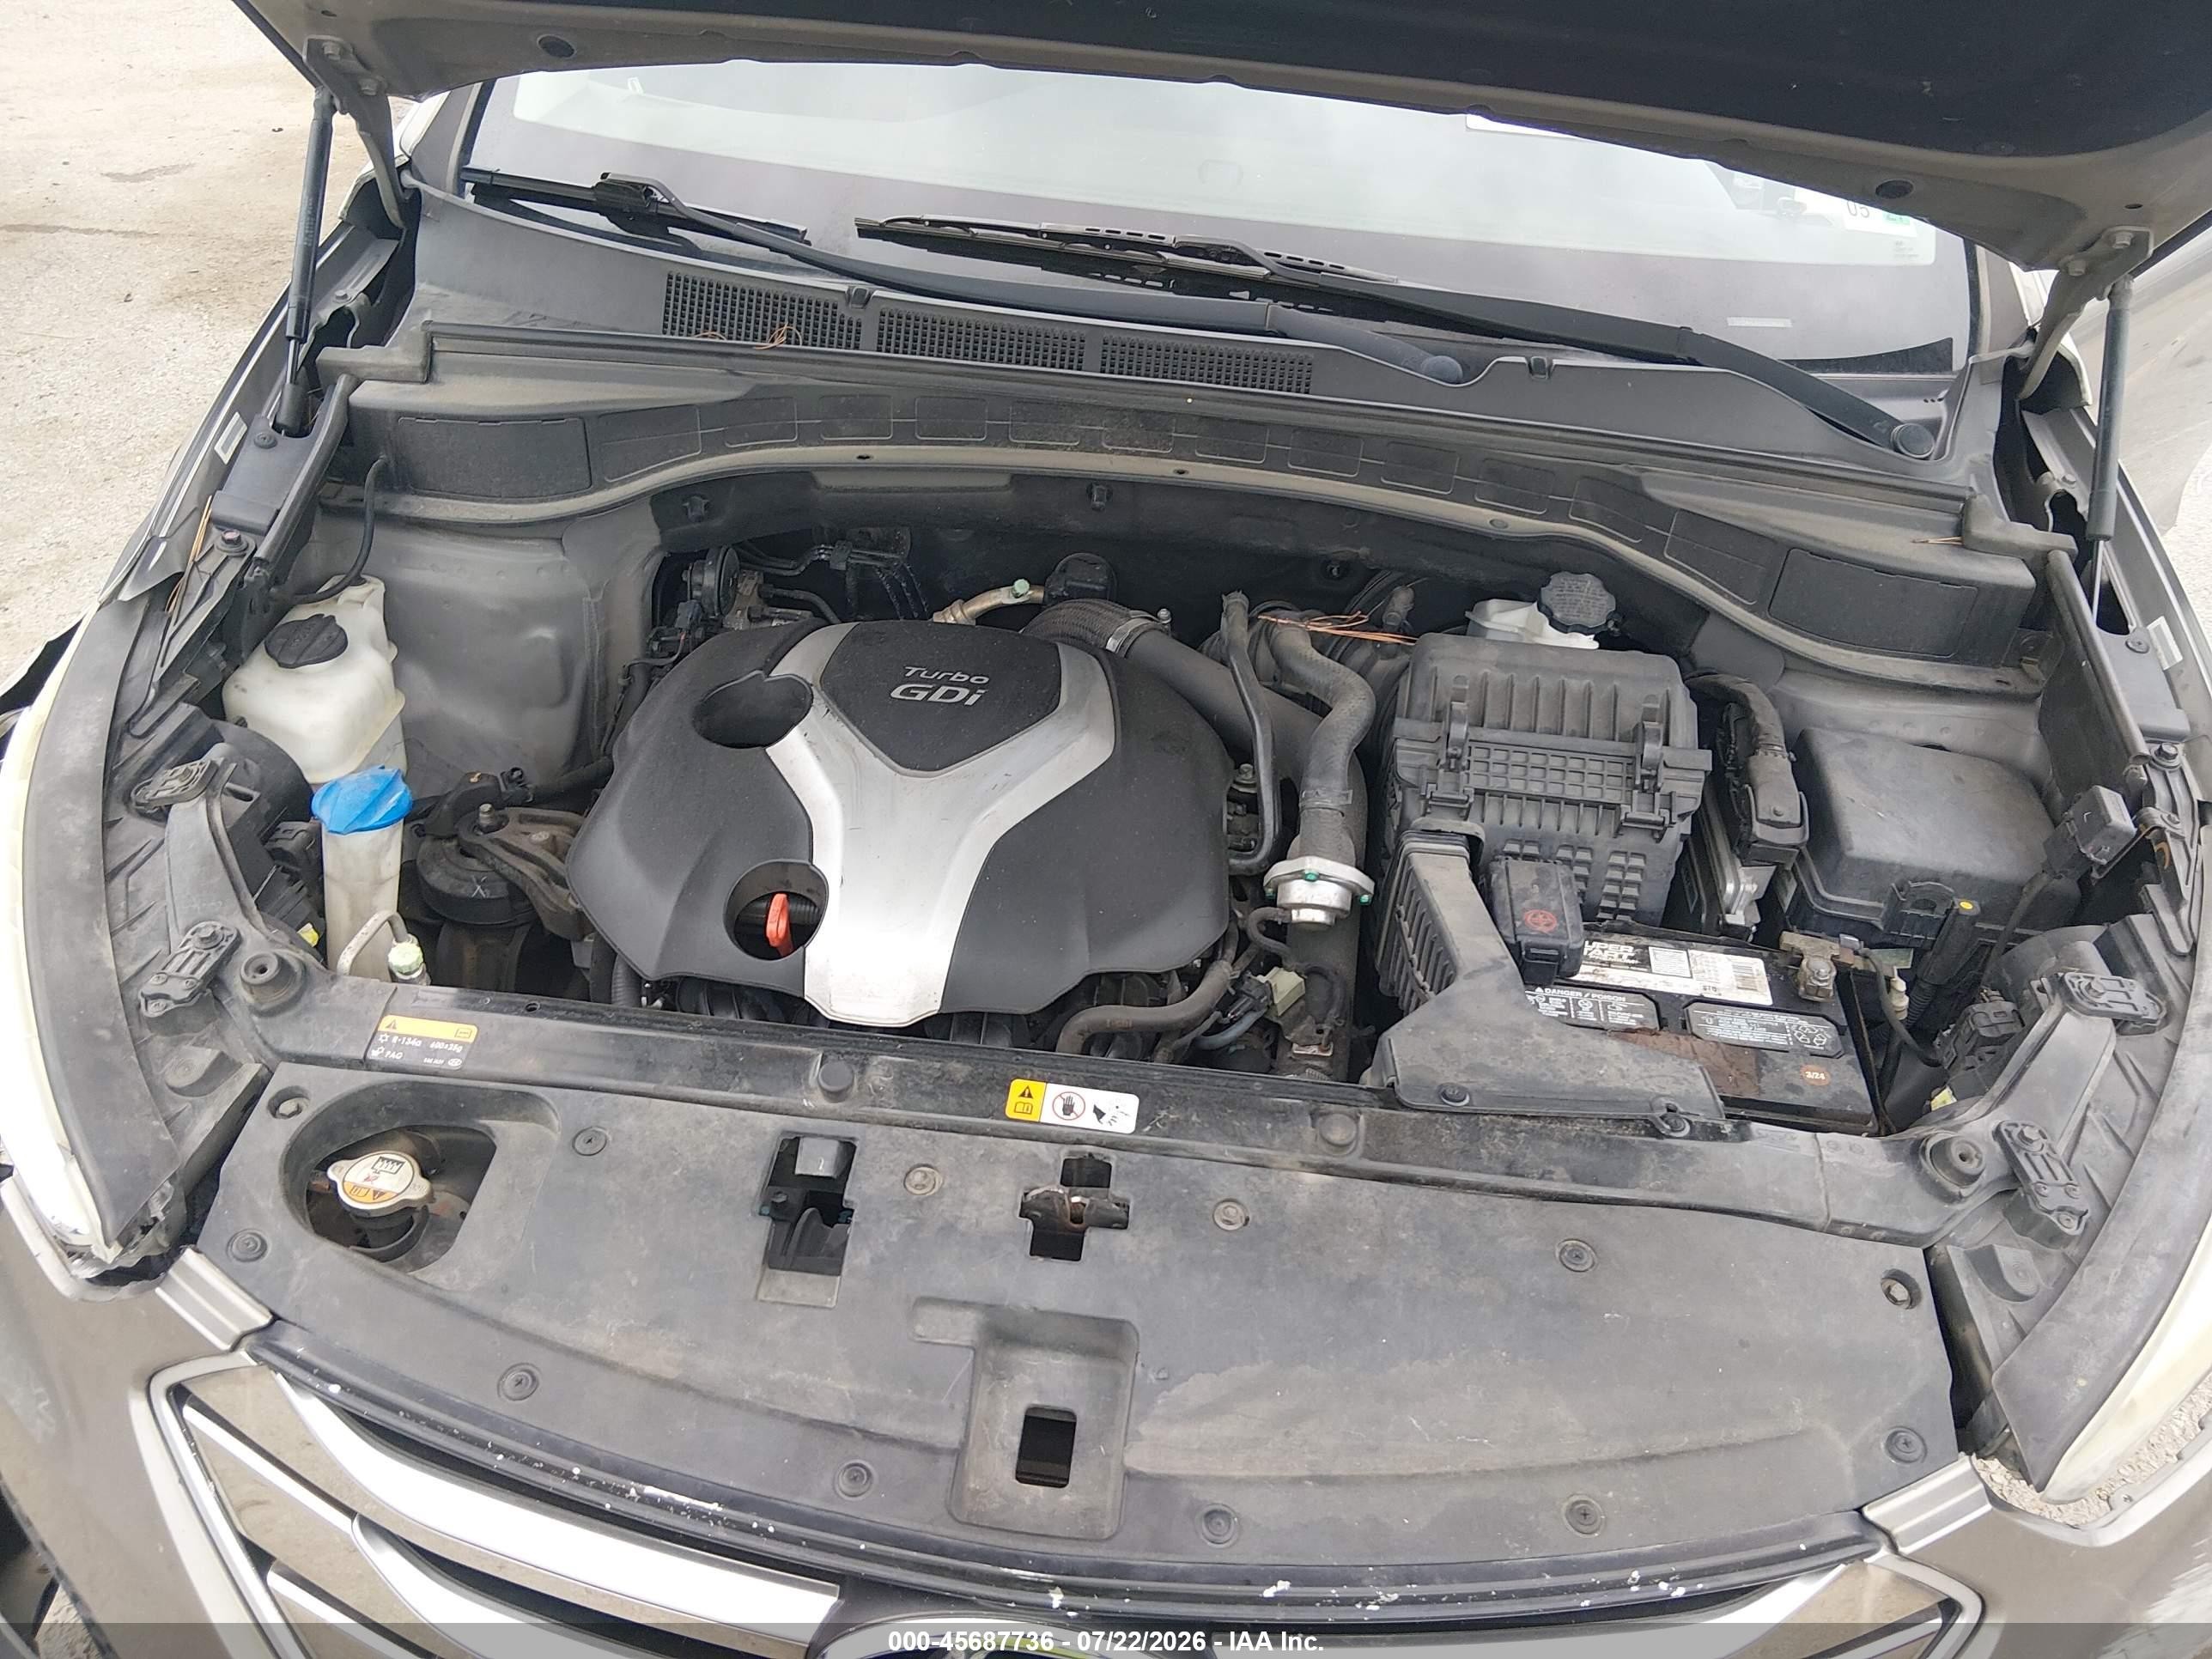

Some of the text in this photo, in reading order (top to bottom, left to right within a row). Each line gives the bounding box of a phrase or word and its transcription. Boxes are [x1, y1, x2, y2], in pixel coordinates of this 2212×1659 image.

[904, 665, 990, 684] Turbo
[890, 684, 989, 706] GDi
[1584, 940, 1635, 952] UPER
[1583, 947, 1637, 960] TART
[1544, 988, 1583, 998] DANGER
[1591, 993, 1626, 1002] POISON
